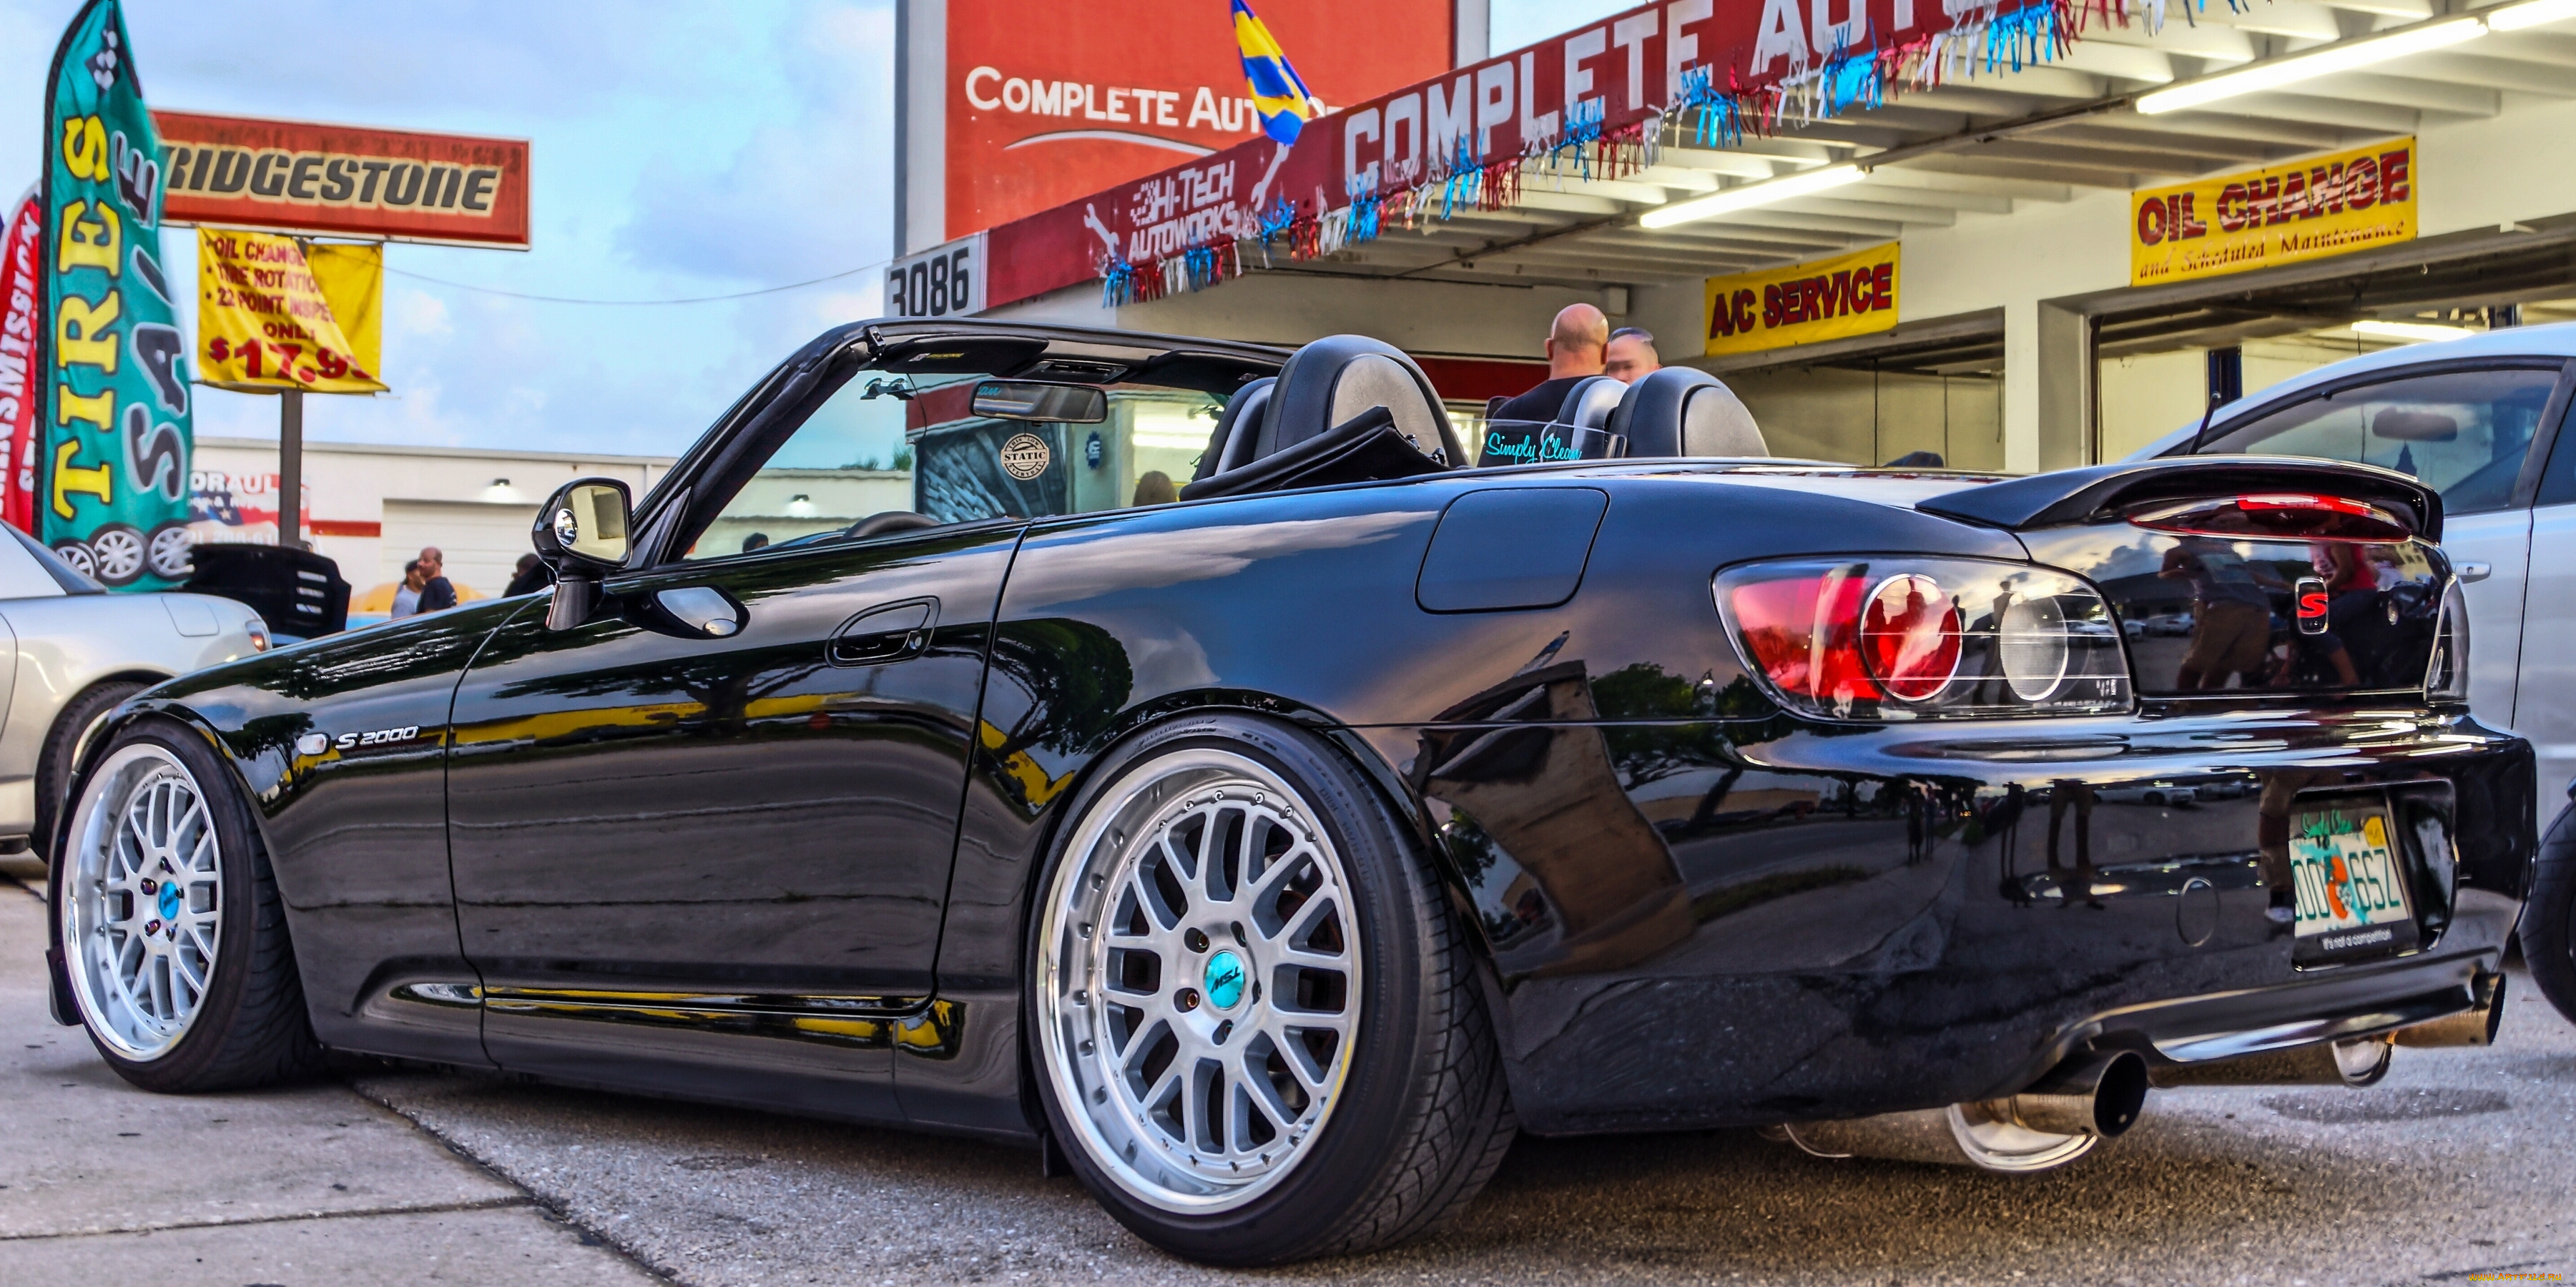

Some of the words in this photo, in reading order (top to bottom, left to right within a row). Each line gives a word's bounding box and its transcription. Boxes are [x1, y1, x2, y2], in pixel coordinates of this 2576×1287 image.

[1344, 0, 1714, 197] COMPLETE
[165, 146, 498, 211] RIDGESTONE
[2138, 192, 2206, 246] OIL
[2216, 148, 2410, 232] CHANGE
[214, 237, 240, 260] OIL
[890, 246, 969, 316] 3086
[2140, 247, 2177, 279] and
[51, 114, 122, 520] TIRES
[238, 290, 284, 314] POINT
[1709, 288, 1756, 340] A/C
[1762, 262, 1893, 329] SERVICE
[1004, 451, 1046, 461] STATIC
[1486, 432, 1538, 465] Simply
[1540, 436, 1583, 461] Clean
